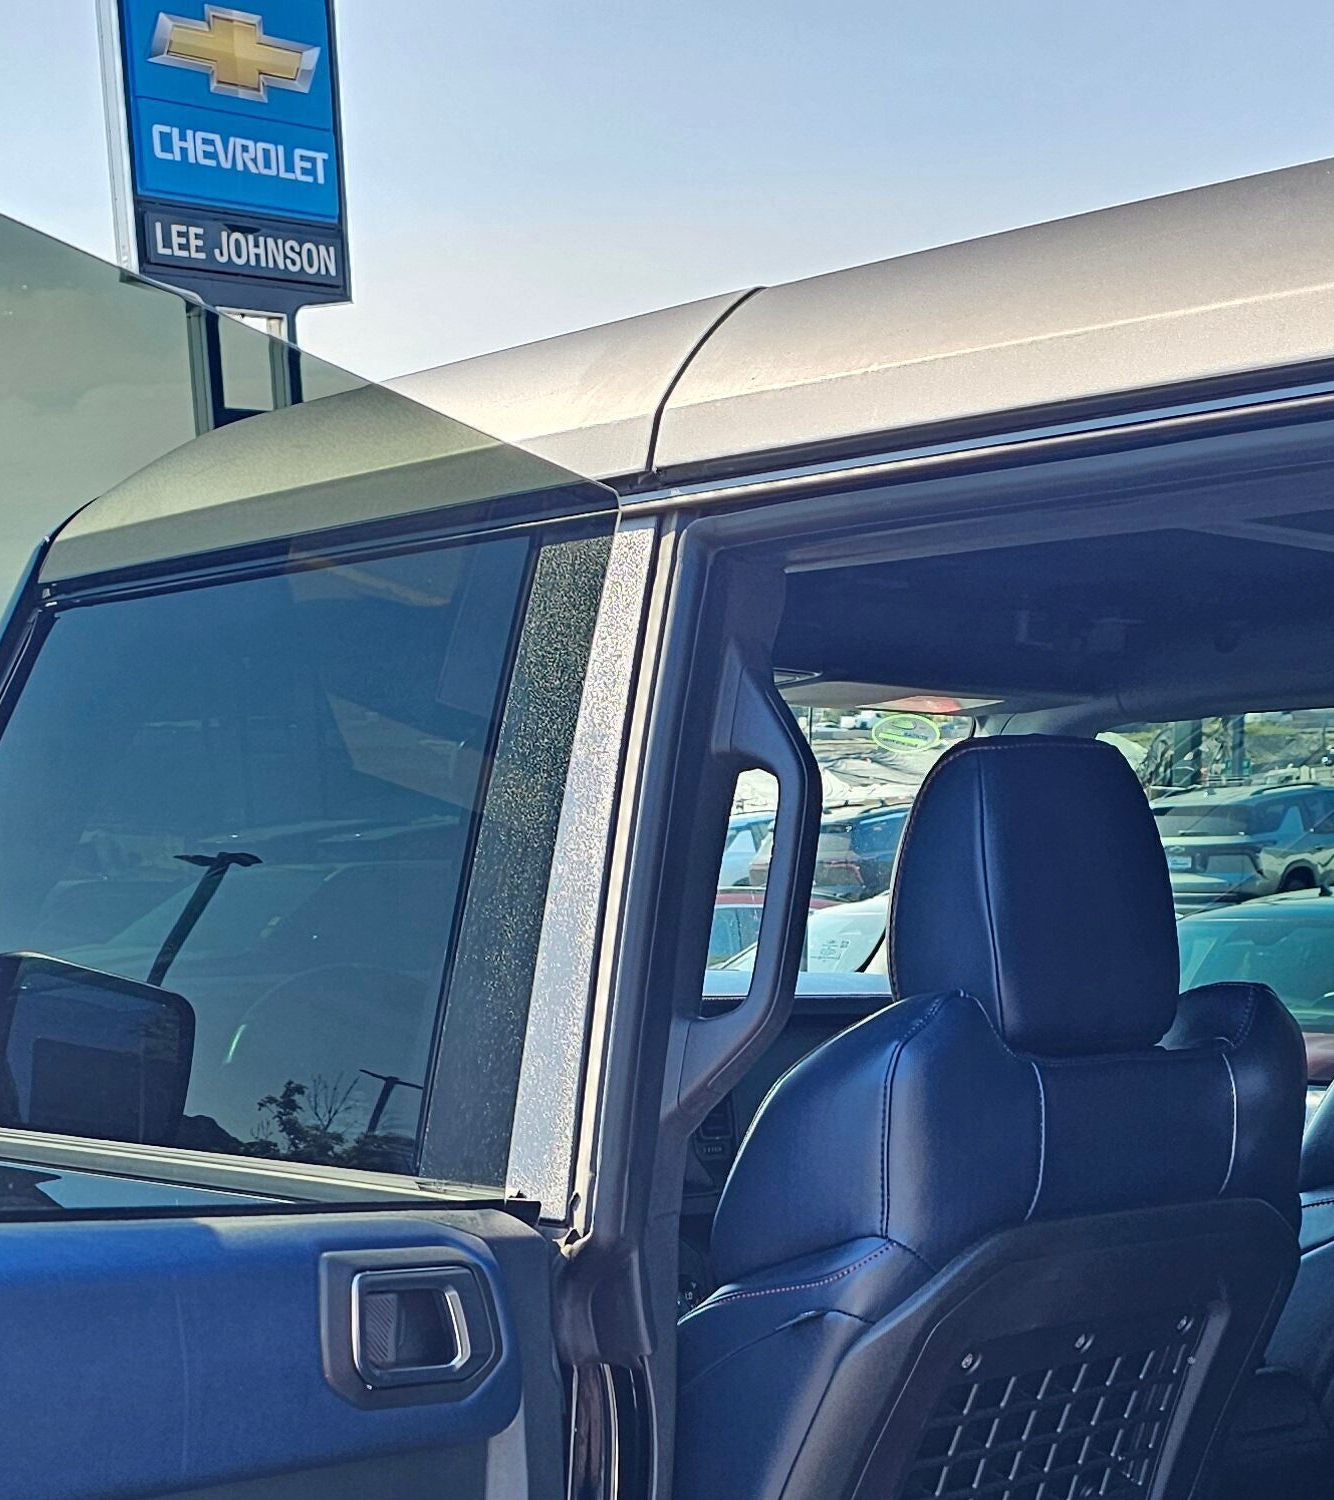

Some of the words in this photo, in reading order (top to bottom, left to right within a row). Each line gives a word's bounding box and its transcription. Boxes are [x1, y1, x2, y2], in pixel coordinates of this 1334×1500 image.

[152, 124, 328, 185] CHEVROLET
[155, 221, 206, 259] LEE
[214, 231, 336, 276] JOHNSON
